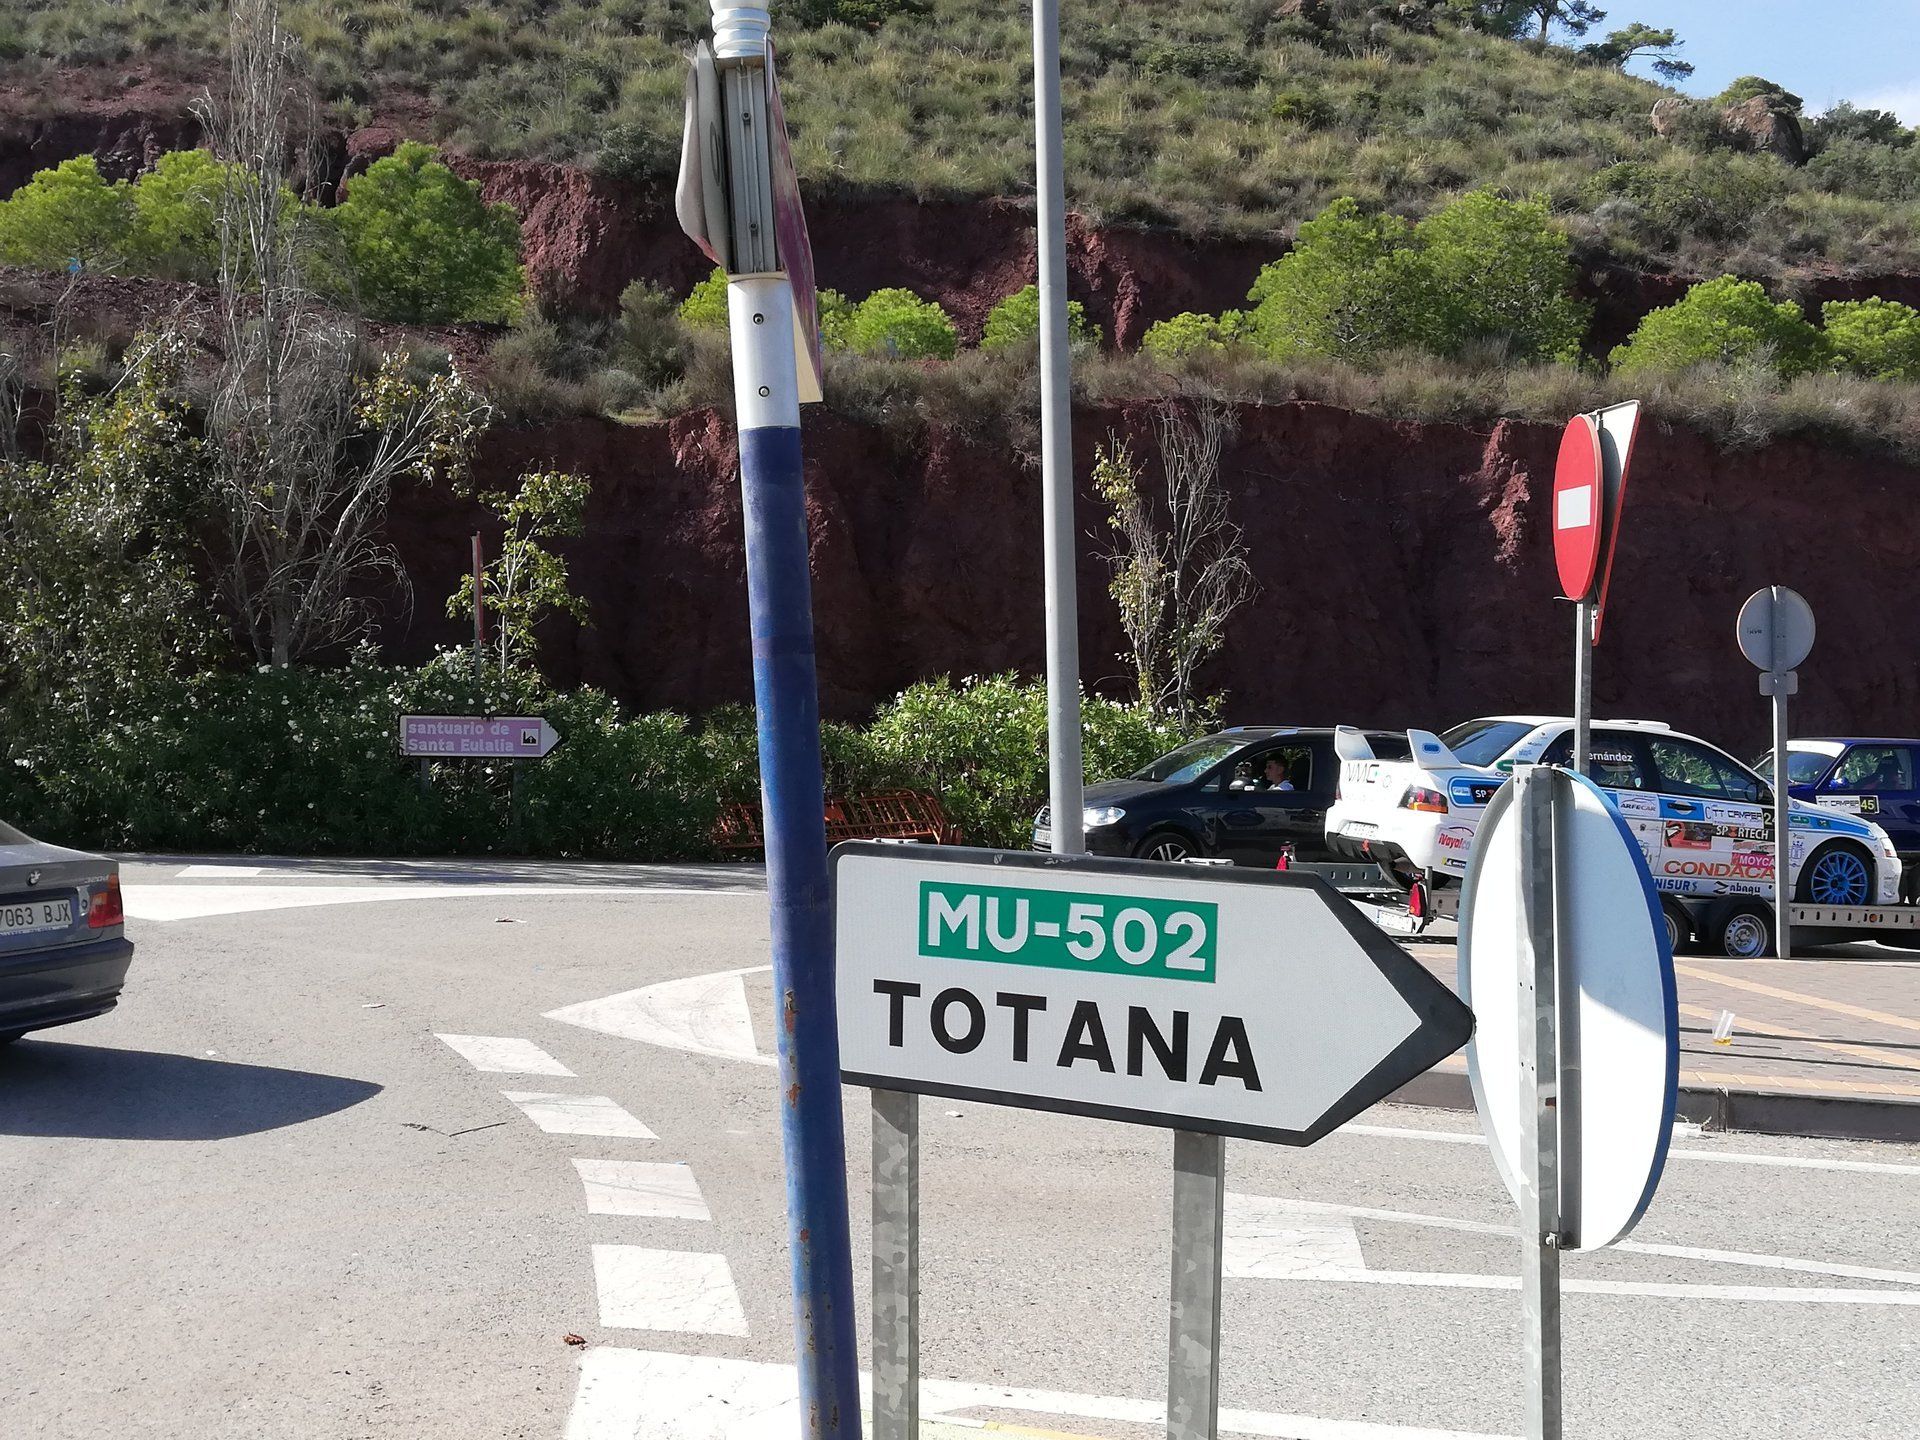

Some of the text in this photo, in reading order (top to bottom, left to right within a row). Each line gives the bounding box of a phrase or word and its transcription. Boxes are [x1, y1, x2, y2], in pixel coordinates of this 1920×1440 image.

[408, 722, 510, 735] santuario de
[408, 739, 514, 752] Santa Eulalia
[1861, 799, 1875, 810] 45
[1727, 810, 1763, 820] CAMPER
[43, 903, 71, 923] BJX
[926, 891, 1208, 972] MU-502
[873, 978, 1263, 1092] TOTANA
